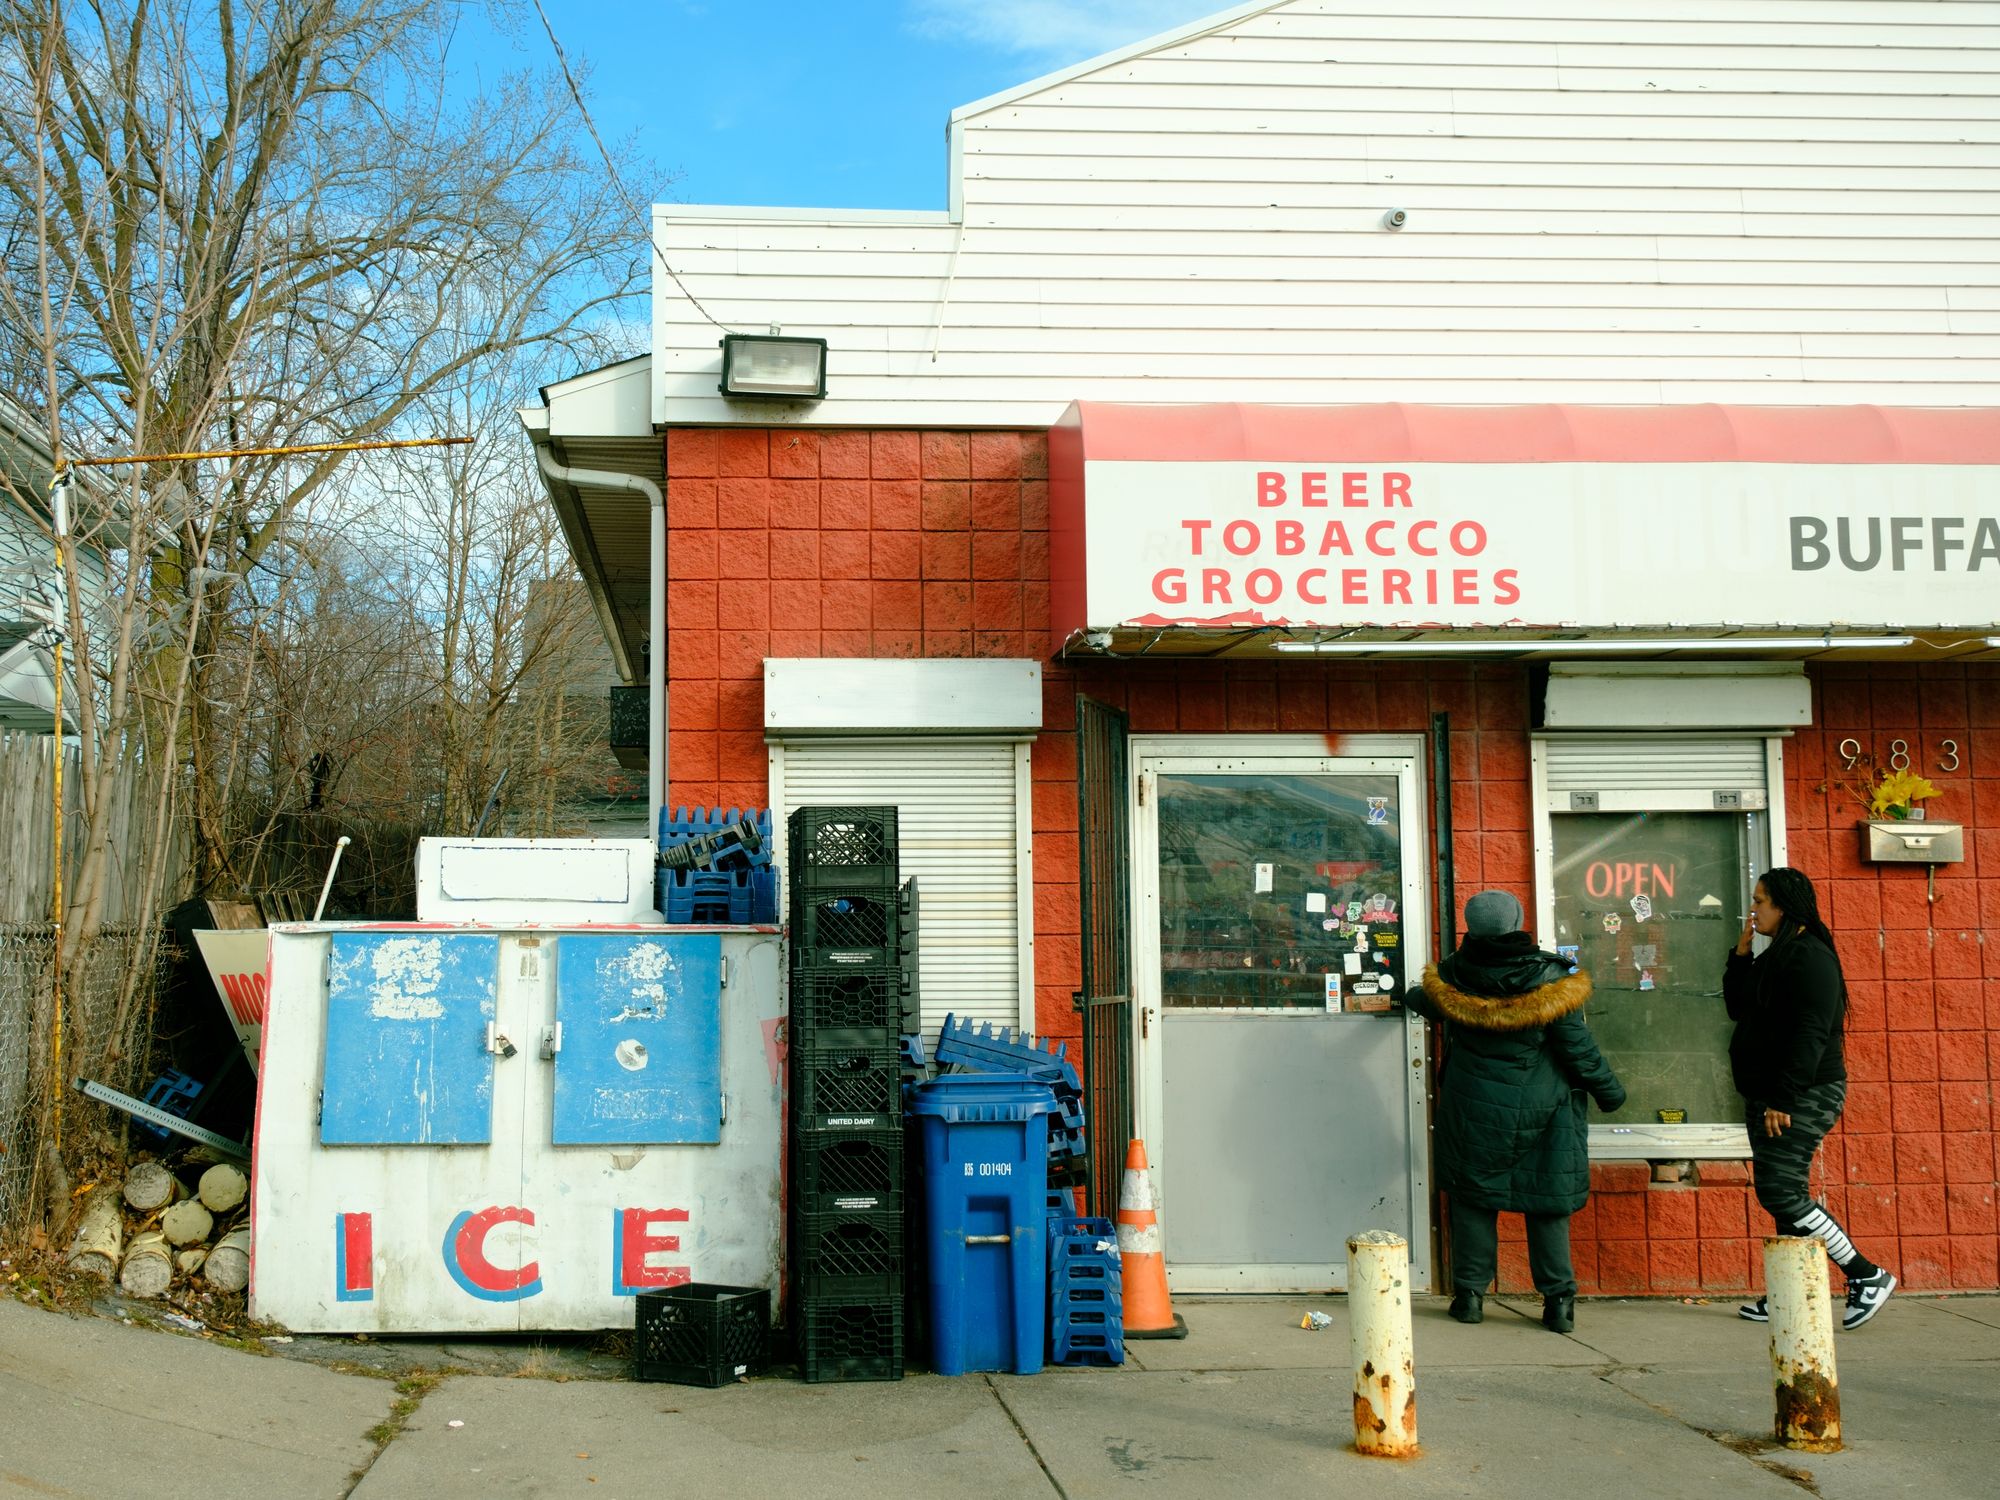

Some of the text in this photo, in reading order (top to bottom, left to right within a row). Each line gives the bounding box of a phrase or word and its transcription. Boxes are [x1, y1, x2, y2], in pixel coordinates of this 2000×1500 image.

[1256, 471, 1414, 508] BEER
[1181, 519, 1488, 557] TOBACCO
[1789, 516, 2000, 572] BUFFA
[1151, 567, 1522, 605] GROCERIES
[1839, 738, 1960, 772] 983
[1585, 860, 1675, 898] OPEN
[979, 1162, 1012, 1176] 001404
[335, 1205, 691, 1302] ICE
